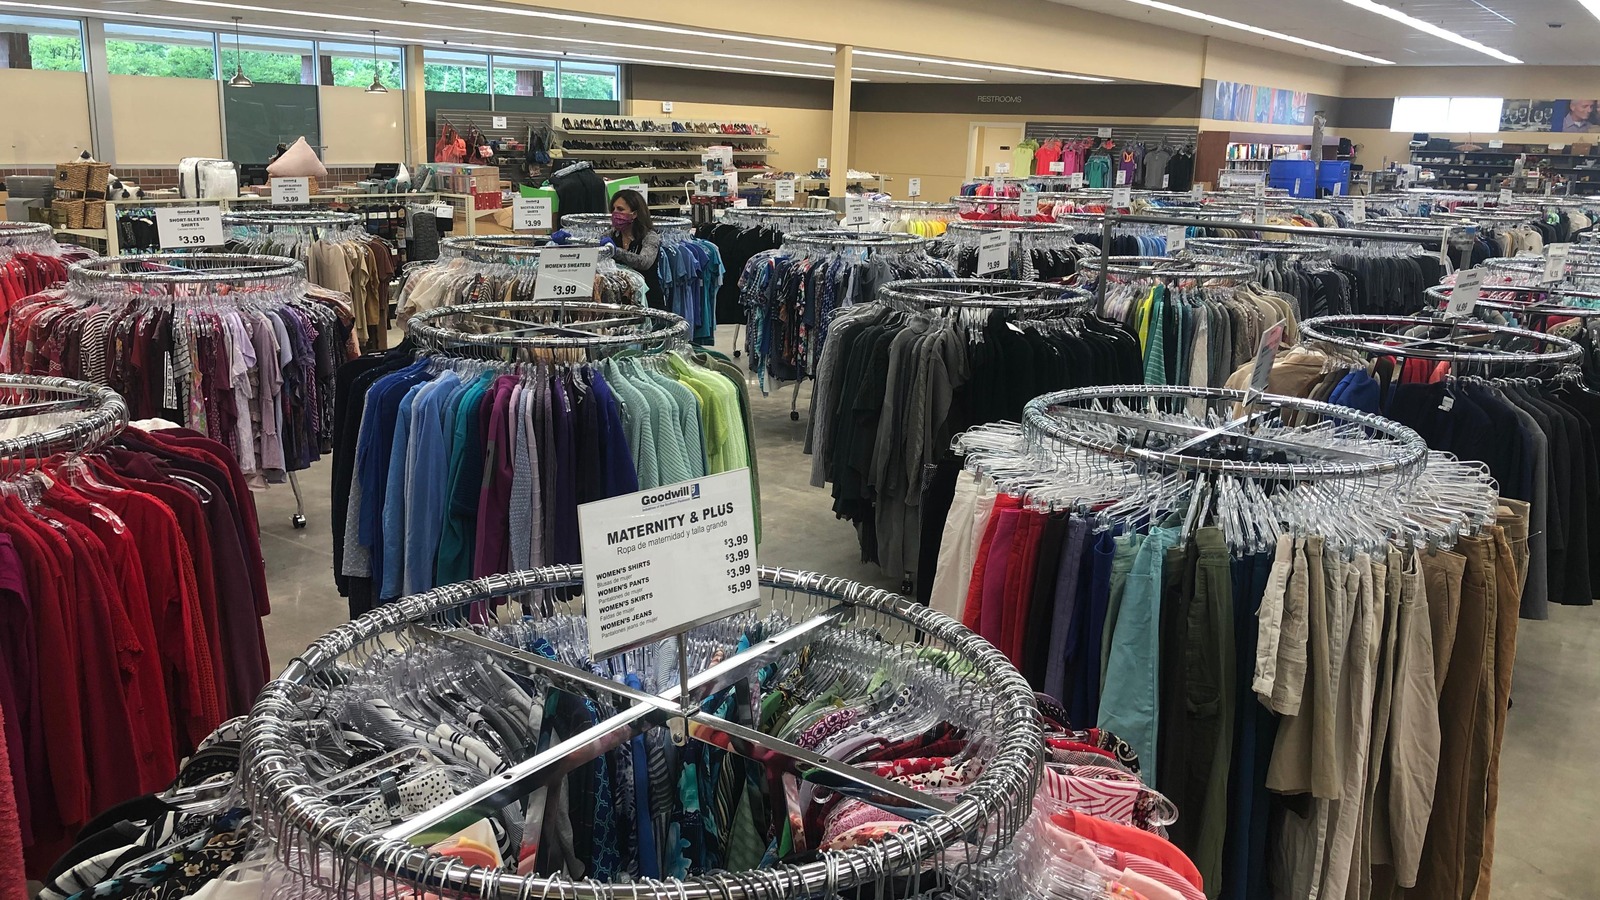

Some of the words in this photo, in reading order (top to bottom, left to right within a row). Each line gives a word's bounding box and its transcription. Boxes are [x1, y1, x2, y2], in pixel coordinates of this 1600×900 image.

[977, 95, 1022, 103] RESTROOMS
[525, 219, 541, 227] $3.99
[178, 235, 206, 244] $3.99
[987, 260, 1000, 270] $3.99
[553, 285, 577, 295] $3.99
[641, 486, 689, 506] Goodwill
[607, 514, 686, 546] MATERNITY
[689, 511, 699, 523] &
[702, 502, 734, 520] PLUS
[617, 545, 636, 556] Ropa
[637, 541, 647, 550] de
[648, 530, 685, 548] maternidad
[686, 530, 691, 539] y
[691, 525, 705, 536] talla
[706, 519, 728, 533] grande
[724, 534, 749, 548] $3.99
[725, 548, 750, 563] $3.99
[595, 566, 627, 581] WOMEN'S
[627, 559, 651, 573] SHIRTS
[726, 564, 751, 579] $3.99
[596, 578, 612, 588] Blusas
[612, 576, 620, 584] de
[620, 573, 633, 583] mujer
[597, 583, 628, 597] WOMEN'S
[629, 577, 650, 588] PANTS
[727, 579, 752, 594] $5.99
[598, 593, 624, 605] Pantalones
[631, 587, 643, 595] mujer
[599, 599, 630, 614] WOMEN'S
[630, 592, 654, 604] SKIRTS
[600, 613, 615, 622] Faldas
[600, 616, 631, 631] WOMEN'S
[631, 609, 653, 621] JEANS
[601, 627, 627, 639] Pantalones
[626, 623, 639, 632] jeans
[645, 616, 658, 625] mujer
